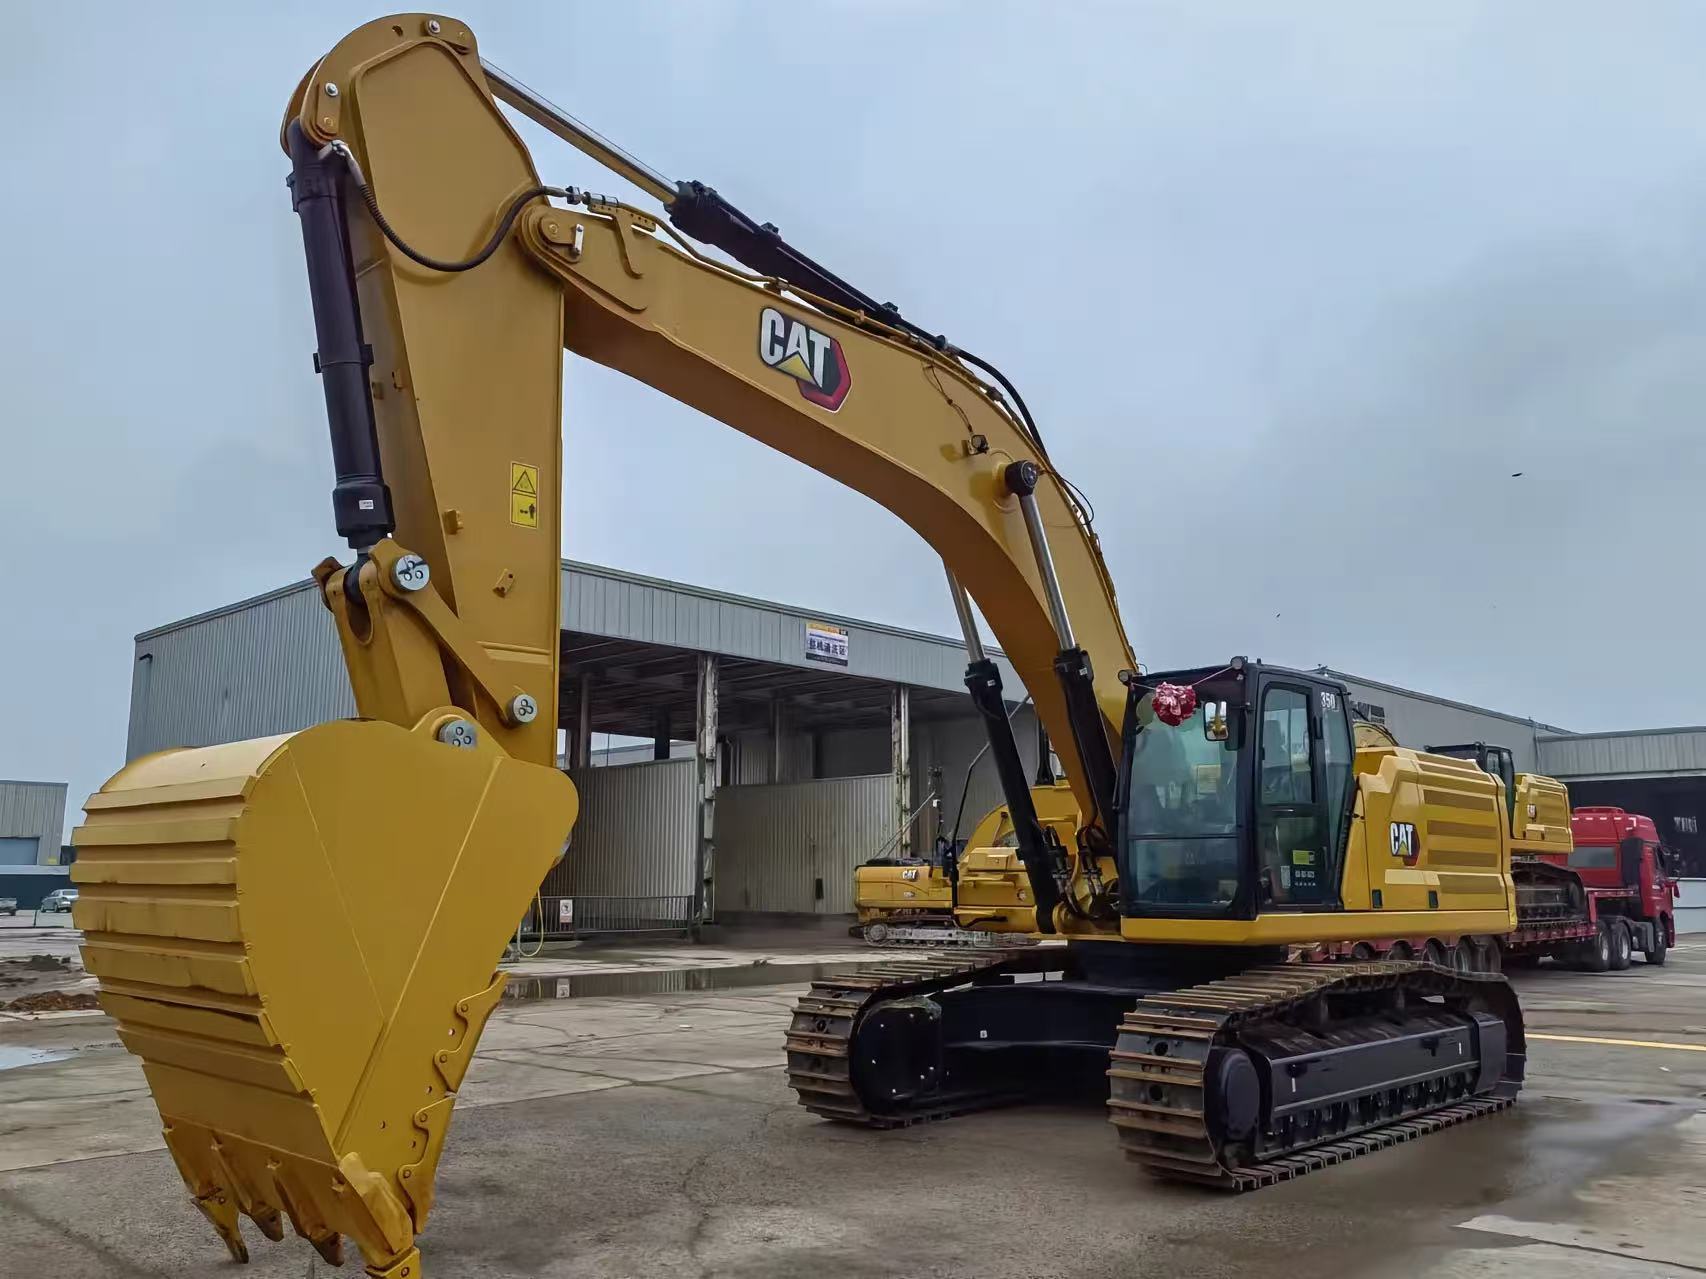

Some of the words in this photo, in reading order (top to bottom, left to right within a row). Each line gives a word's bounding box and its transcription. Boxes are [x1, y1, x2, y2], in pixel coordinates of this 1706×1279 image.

[760, 308, 831, 388] CAT
[1320, 691, 1336, 709] 350
[1390, 822, 1414, 856] CAT
[902, 869, 917, 880] CAT
